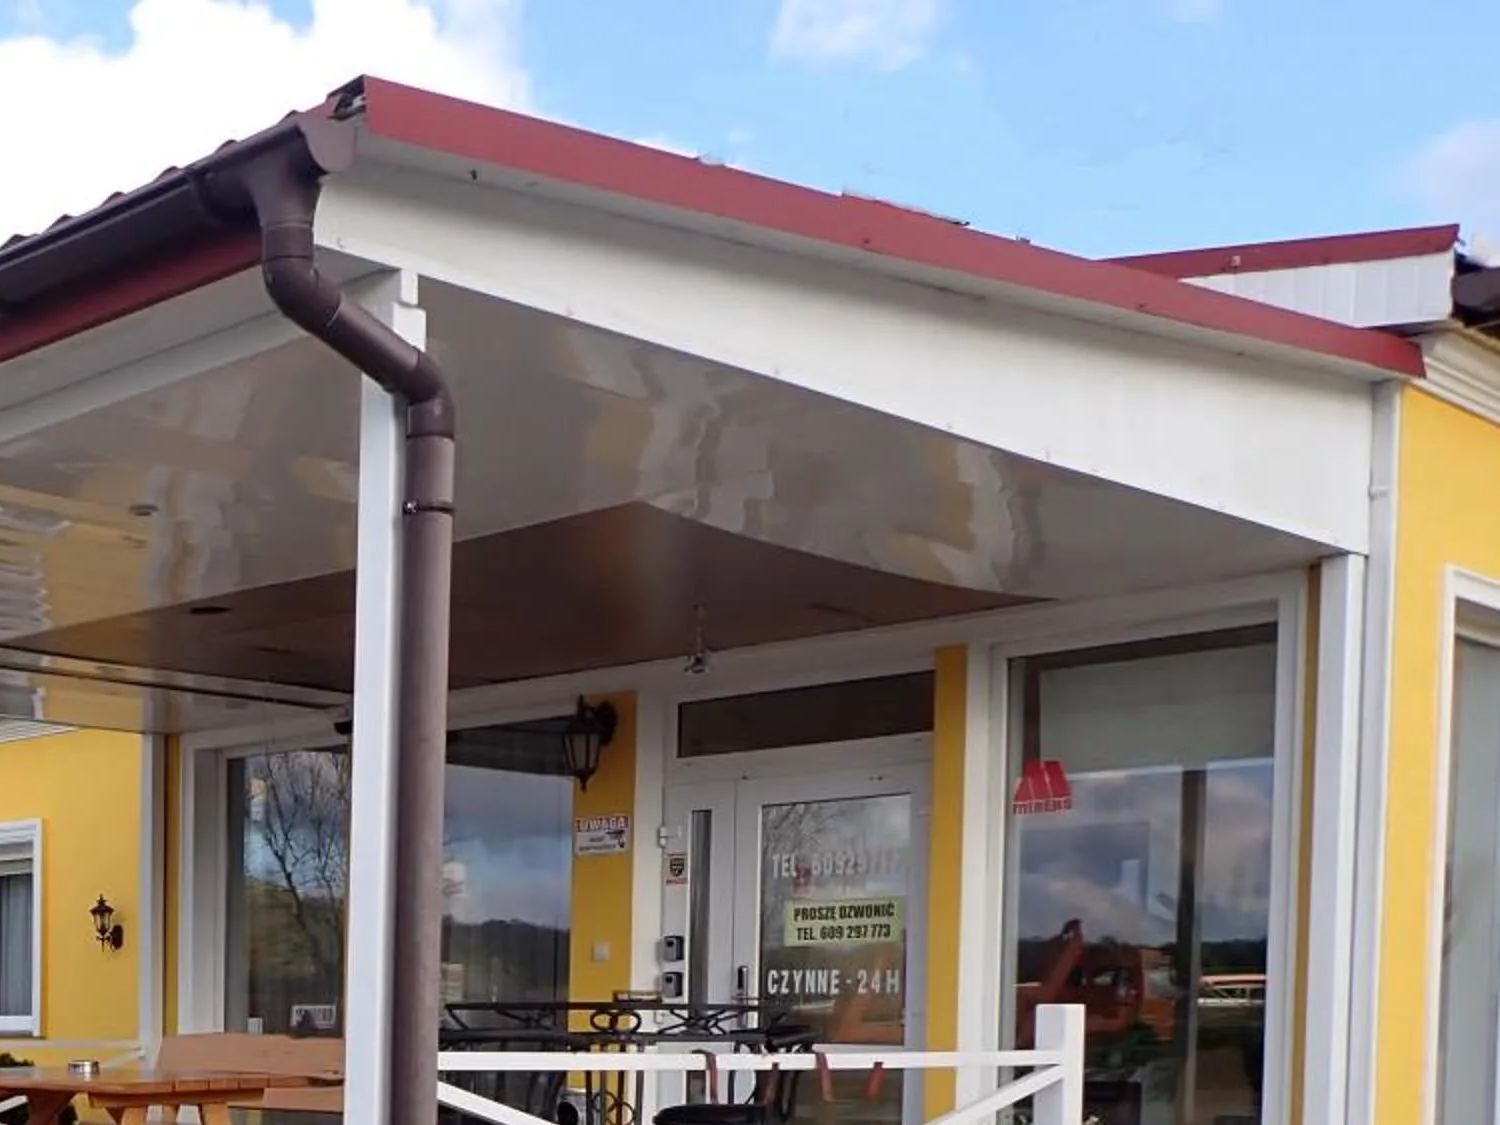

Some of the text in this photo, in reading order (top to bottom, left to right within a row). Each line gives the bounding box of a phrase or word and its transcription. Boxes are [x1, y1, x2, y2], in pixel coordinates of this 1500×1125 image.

[579, 817, 627, 832] UWAGA
[840, 901, 895, 919] DZWONIĆ
[820, 925, 844, 940] 609
[846, 924, 869, 939] 297
[871, 922, 891, 938] 773
[767, 969, 839, 995] CZYNNE
[857, 969, 880, 994] 24
[886, 969, 900, 994] H
